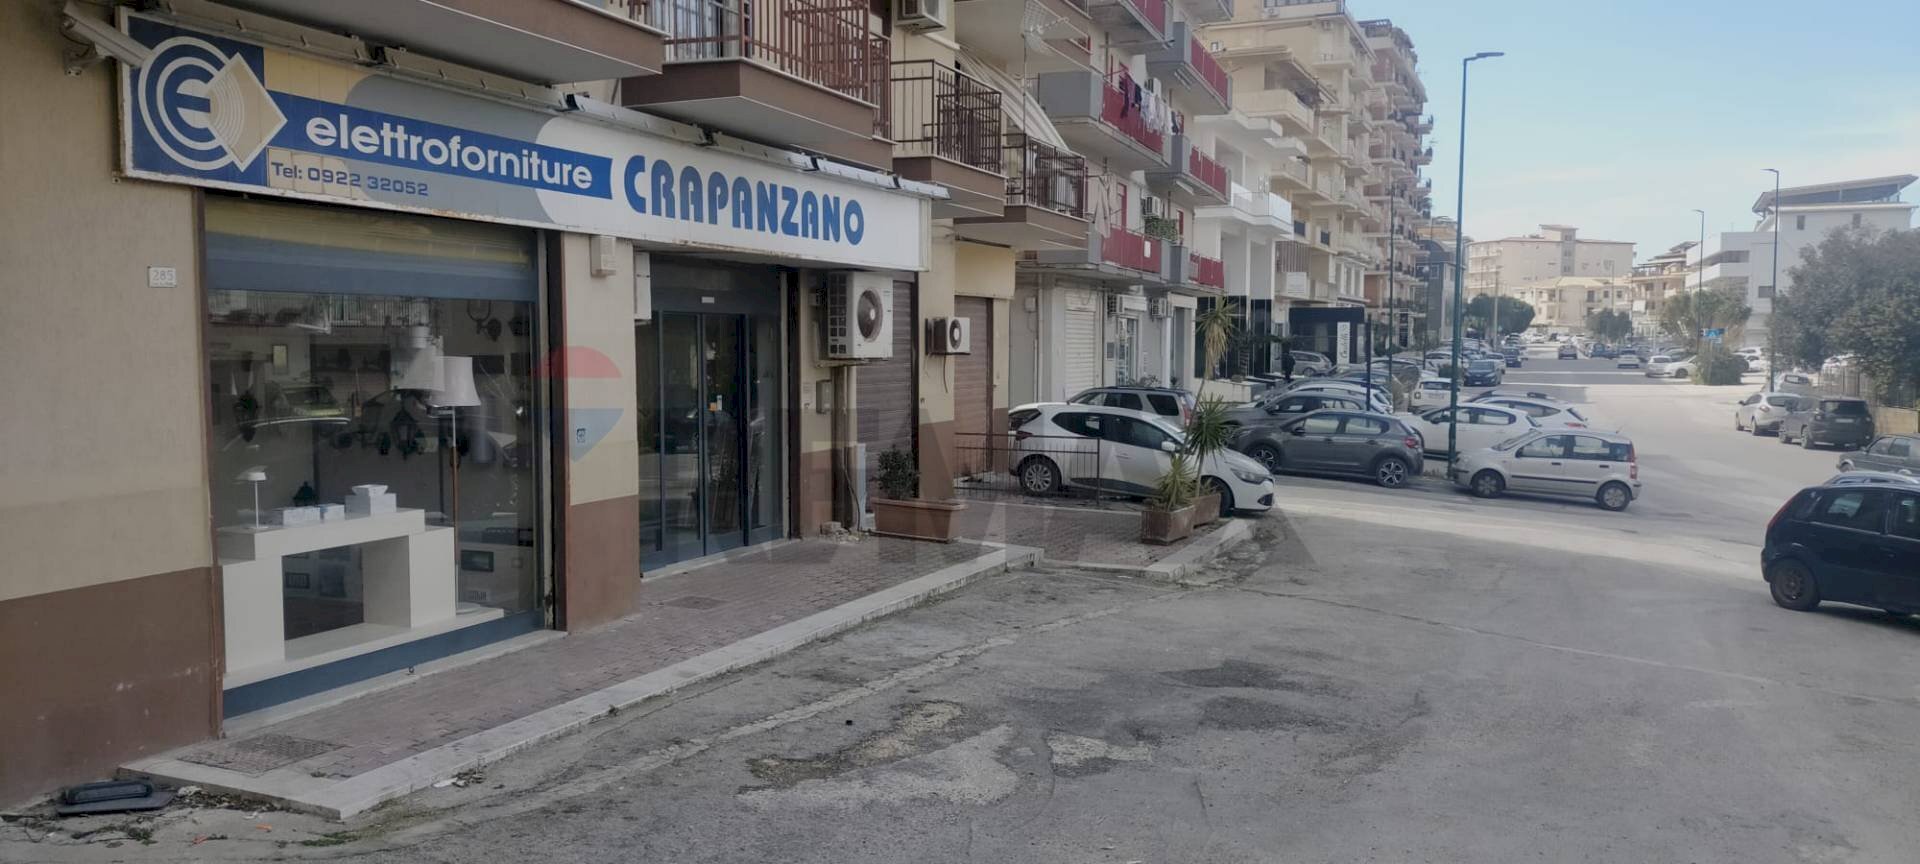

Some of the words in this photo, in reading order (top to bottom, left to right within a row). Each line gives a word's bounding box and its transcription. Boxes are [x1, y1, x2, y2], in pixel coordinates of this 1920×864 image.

[305, 114, 593, 189] elettroforniture
[271, 162, 303, 179] Tel:
[307, 167, 361, 187] 0922
[367, 176, 429, 196] 32052
[623, 155, 865, 246] CRAPANZANO
[151, 269, 175, 281] 285
